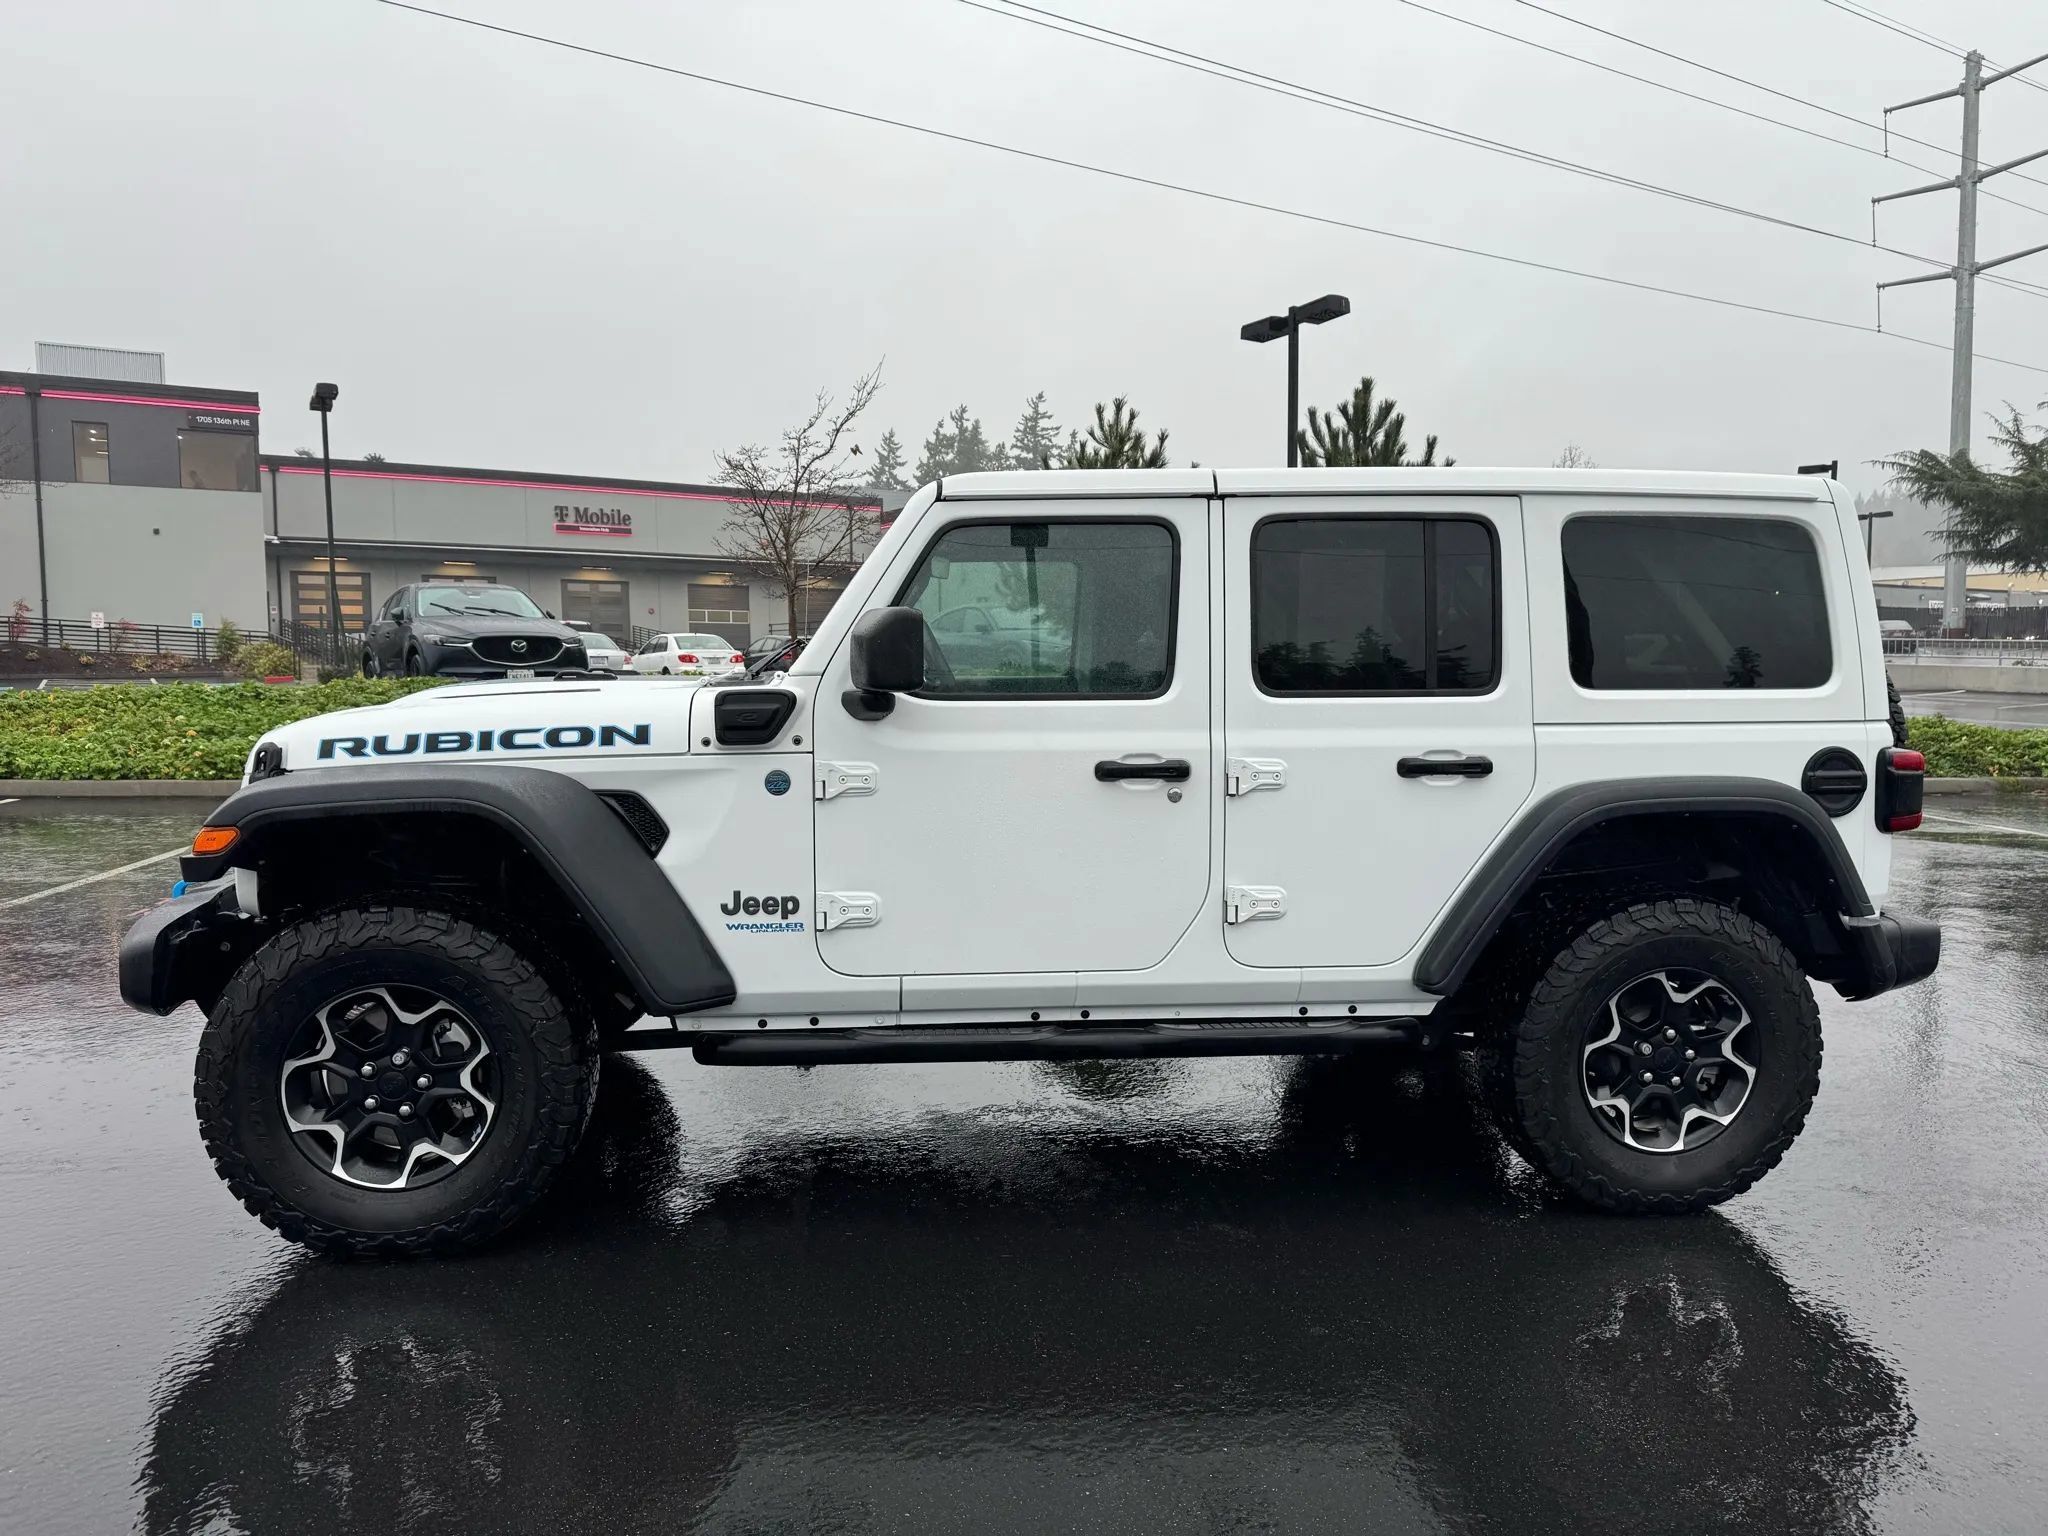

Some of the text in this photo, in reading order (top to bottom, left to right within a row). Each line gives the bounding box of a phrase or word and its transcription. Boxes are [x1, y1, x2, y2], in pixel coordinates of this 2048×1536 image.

[195, 415, 213, 423] 1705
[213, 417, 232, 425] 136th
[240, 419, 250, 427] NE
[573, 506, 632, 526] Mobile
[317, 723, 652, 760] RUBICON
[720, 890, 800, 920] Jeep
[725, 922, 804, 930] WRANGLER
